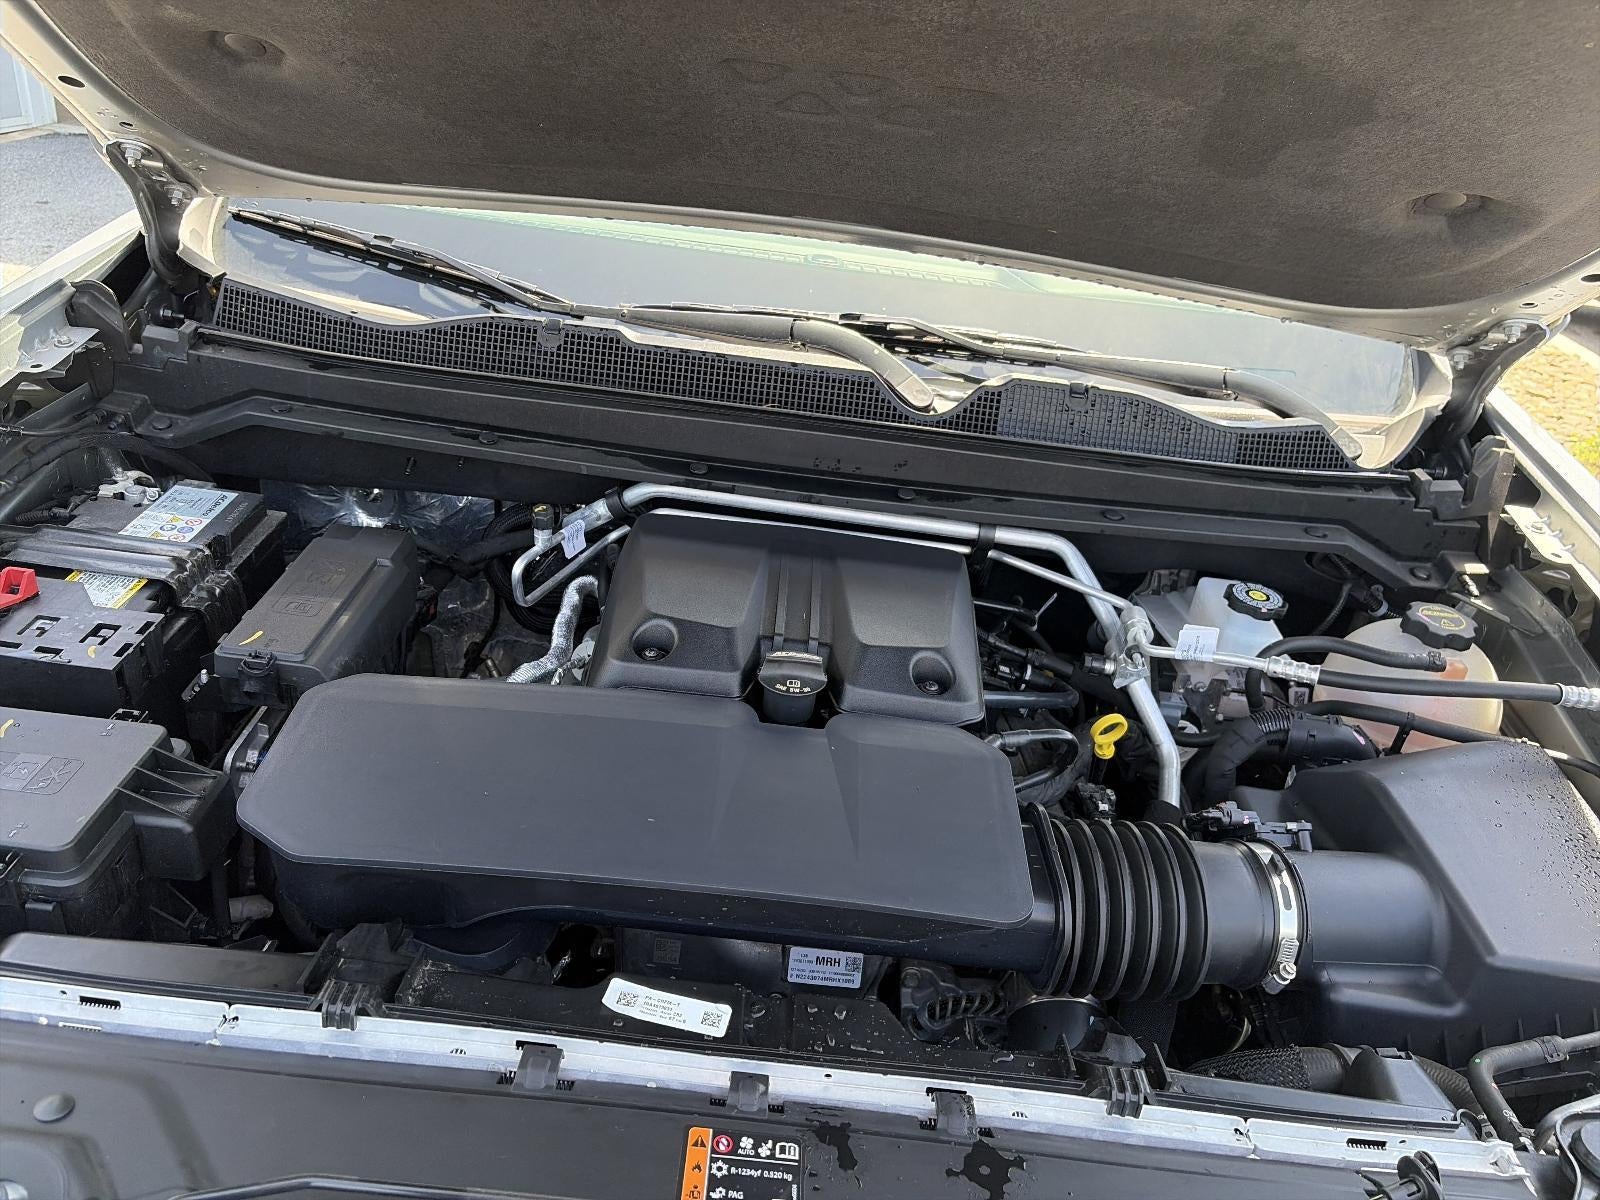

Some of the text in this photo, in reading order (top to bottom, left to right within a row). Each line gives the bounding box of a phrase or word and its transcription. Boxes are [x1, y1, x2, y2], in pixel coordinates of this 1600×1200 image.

[202, 494, 228, 517] ACDelco
[815, 955, 841, 967] MRH
[737, 1148, 755, 1156] AUTO
[730, 1166, 762, 1178] R-1234yf
[783, 1171, 793, 1182] kg
[727, 1190, 744, 1200] PAG
